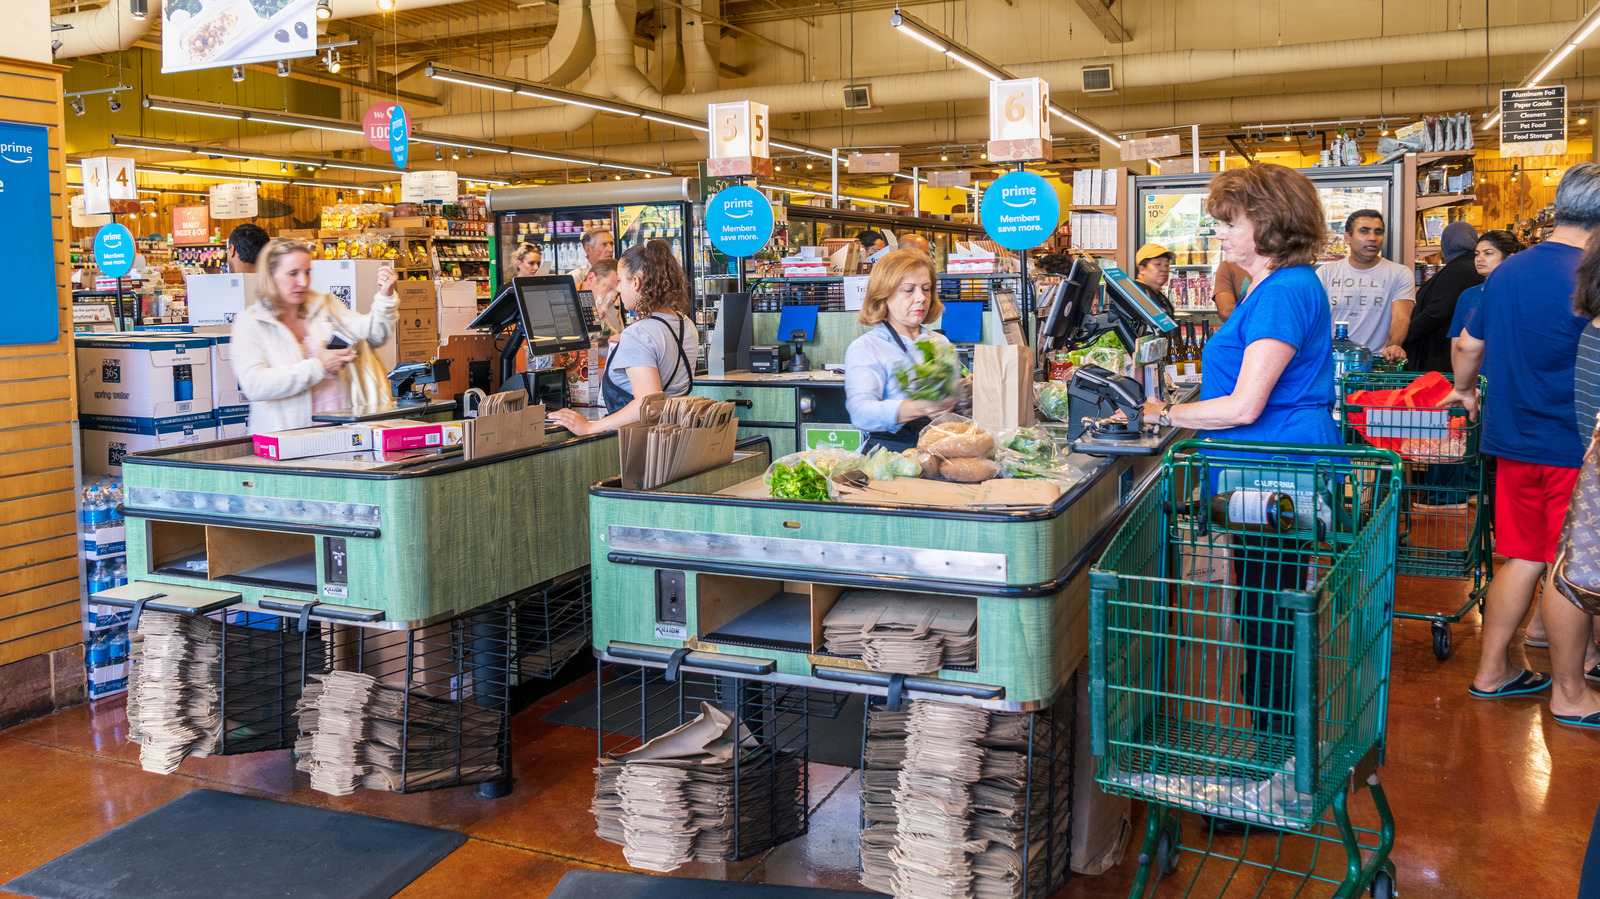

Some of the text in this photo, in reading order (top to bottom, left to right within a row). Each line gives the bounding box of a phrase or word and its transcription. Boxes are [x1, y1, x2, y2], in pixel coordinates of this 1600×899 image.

[1004, 92, 1025, 122] 6
[1042, 94, 1048, 122] 6
[371, 126, 390, 139] LOC
[722, 114, 738, 142] 5
[756, 115, 764, 142] 5
[0, 142, 32, 153] prime
[1151, 140, 1171, 148] Yogurt
[89, 167, 100, 187] 4
[116, 167, 129, 187] 4
[1002, 185, 1036, 199] prime
[724, 198, 753, 211] prime
[1000, 214, 1040, 223] Members
[1148, 210, 1164, 218] 10%
[998, 223, 1042, 232] save more.
[103, 232, 121, 242] prime
[1331, 296, 1384, 307] STER
[104, 367, 118, 379] 365
[94, 391, 111, 399] spring
[110, 451, 123, 462] 365
[656, 626, 680, 635] KILLION
